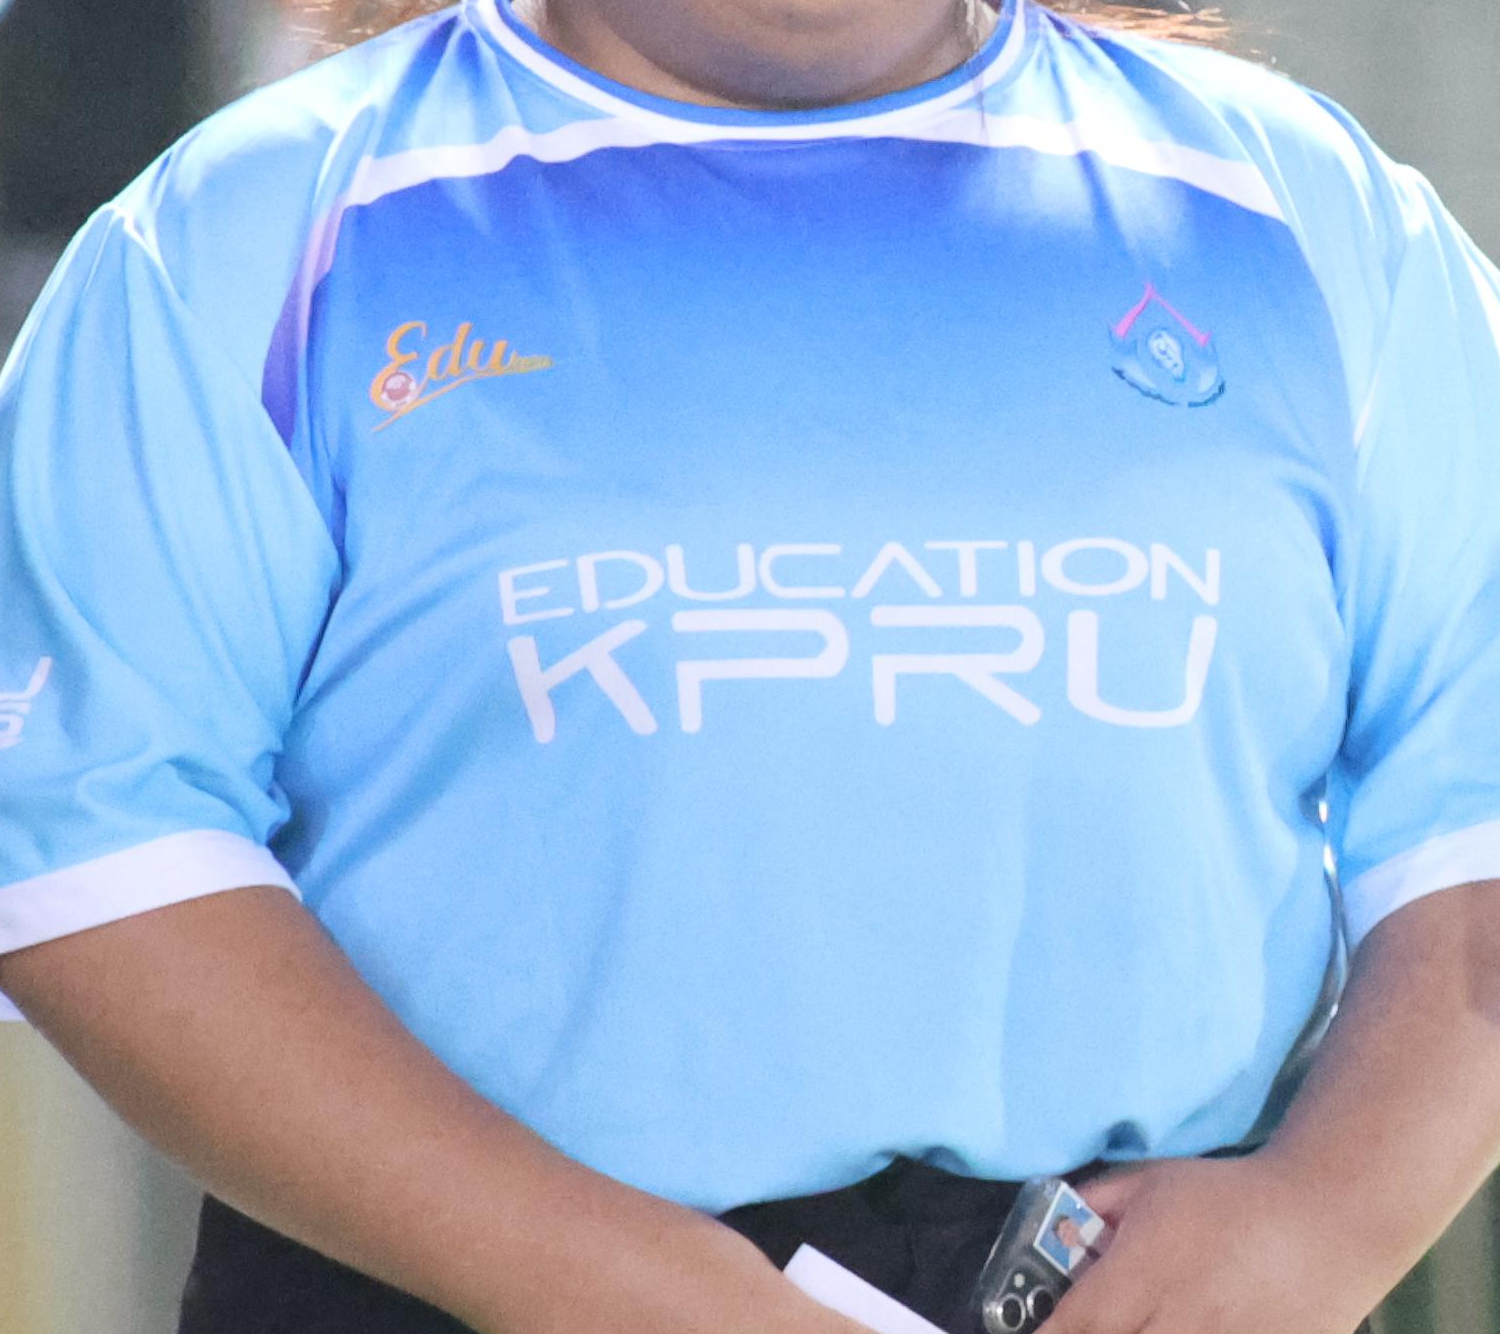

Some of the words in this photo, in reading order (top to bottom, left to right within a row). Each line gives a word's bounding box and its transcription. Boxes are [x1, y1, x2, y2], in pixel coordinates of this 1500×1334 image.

[369, 320, 510, 414] Edu
[498, 537, 1221, 626] EDUCATION
[506, 604, 1219, 745] KPRU
